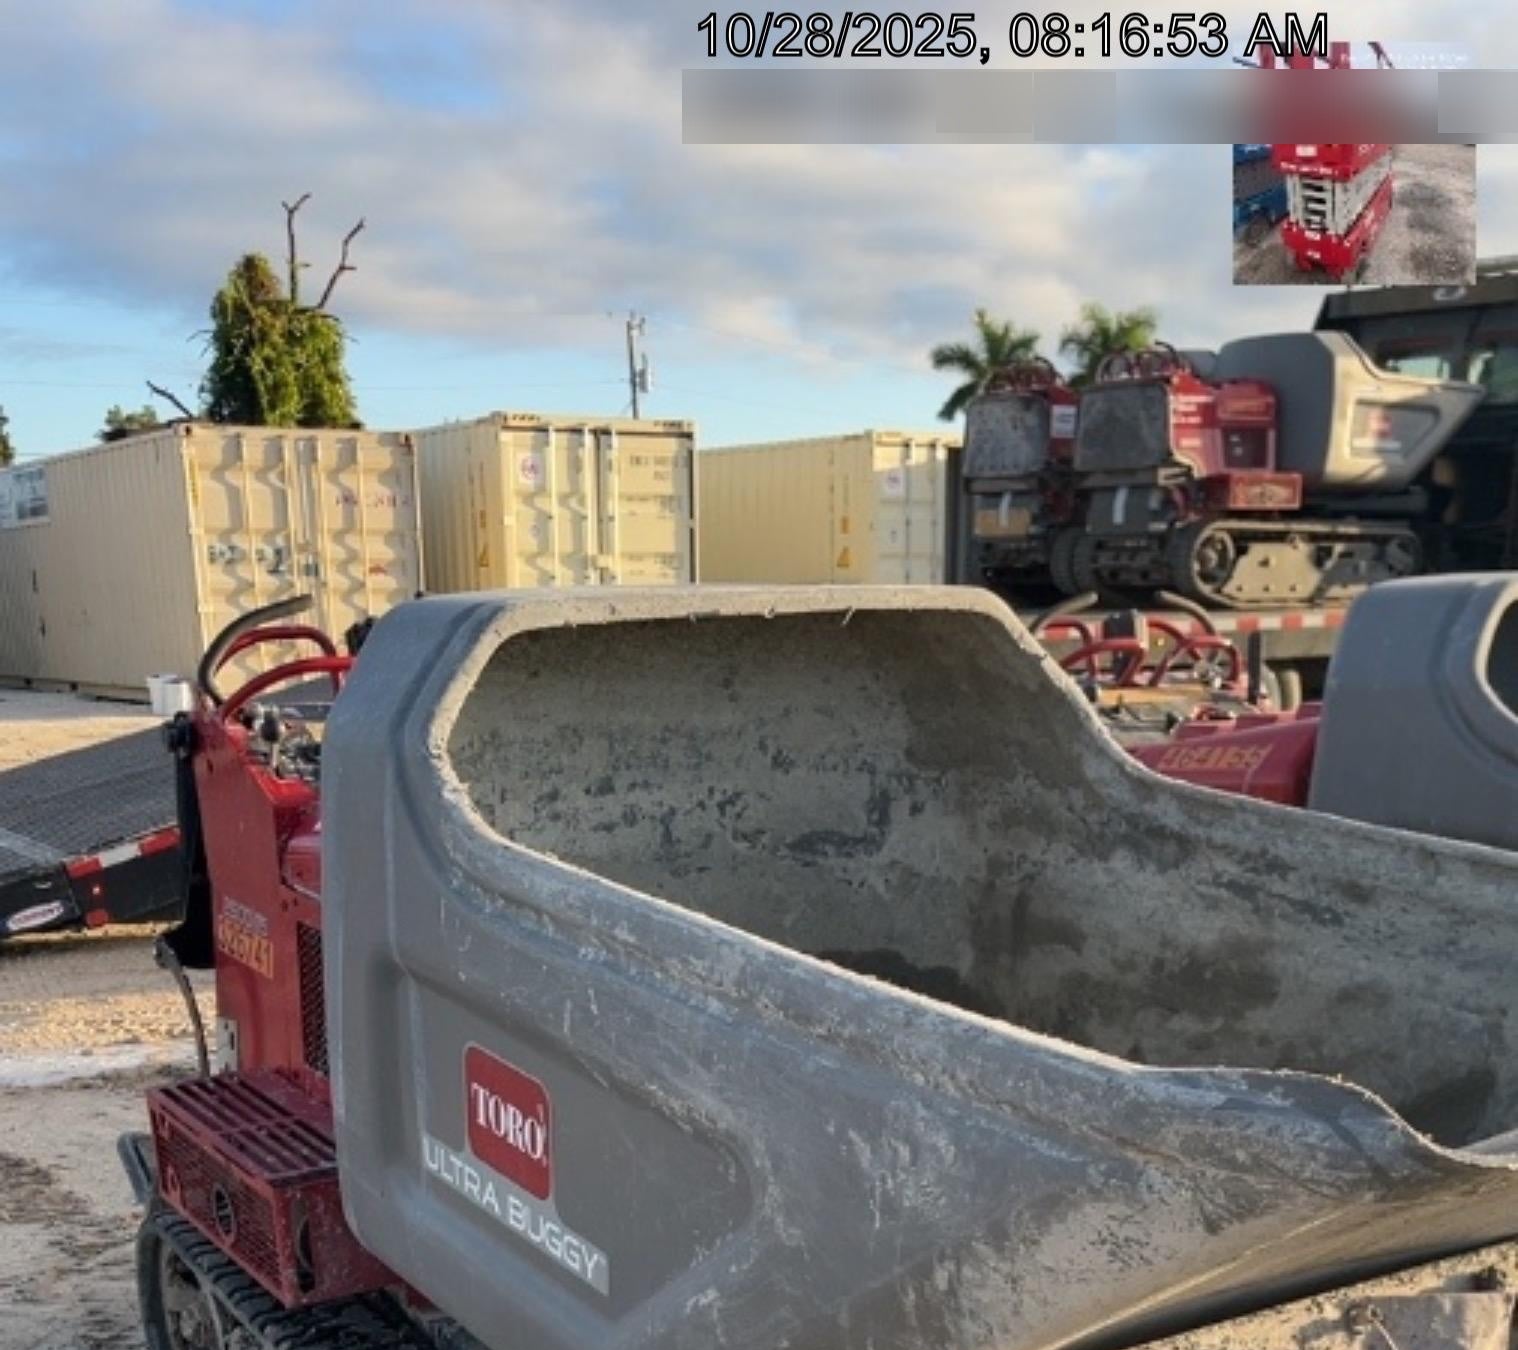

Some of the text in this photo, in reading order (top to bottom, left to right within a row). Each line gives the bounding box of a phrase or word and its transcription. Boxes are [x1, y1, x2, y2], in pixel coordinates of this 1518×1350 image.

[470, 1081, 548, 1161] TORO
[422, 1134, 599, 1280] ULTRA BUGGY
